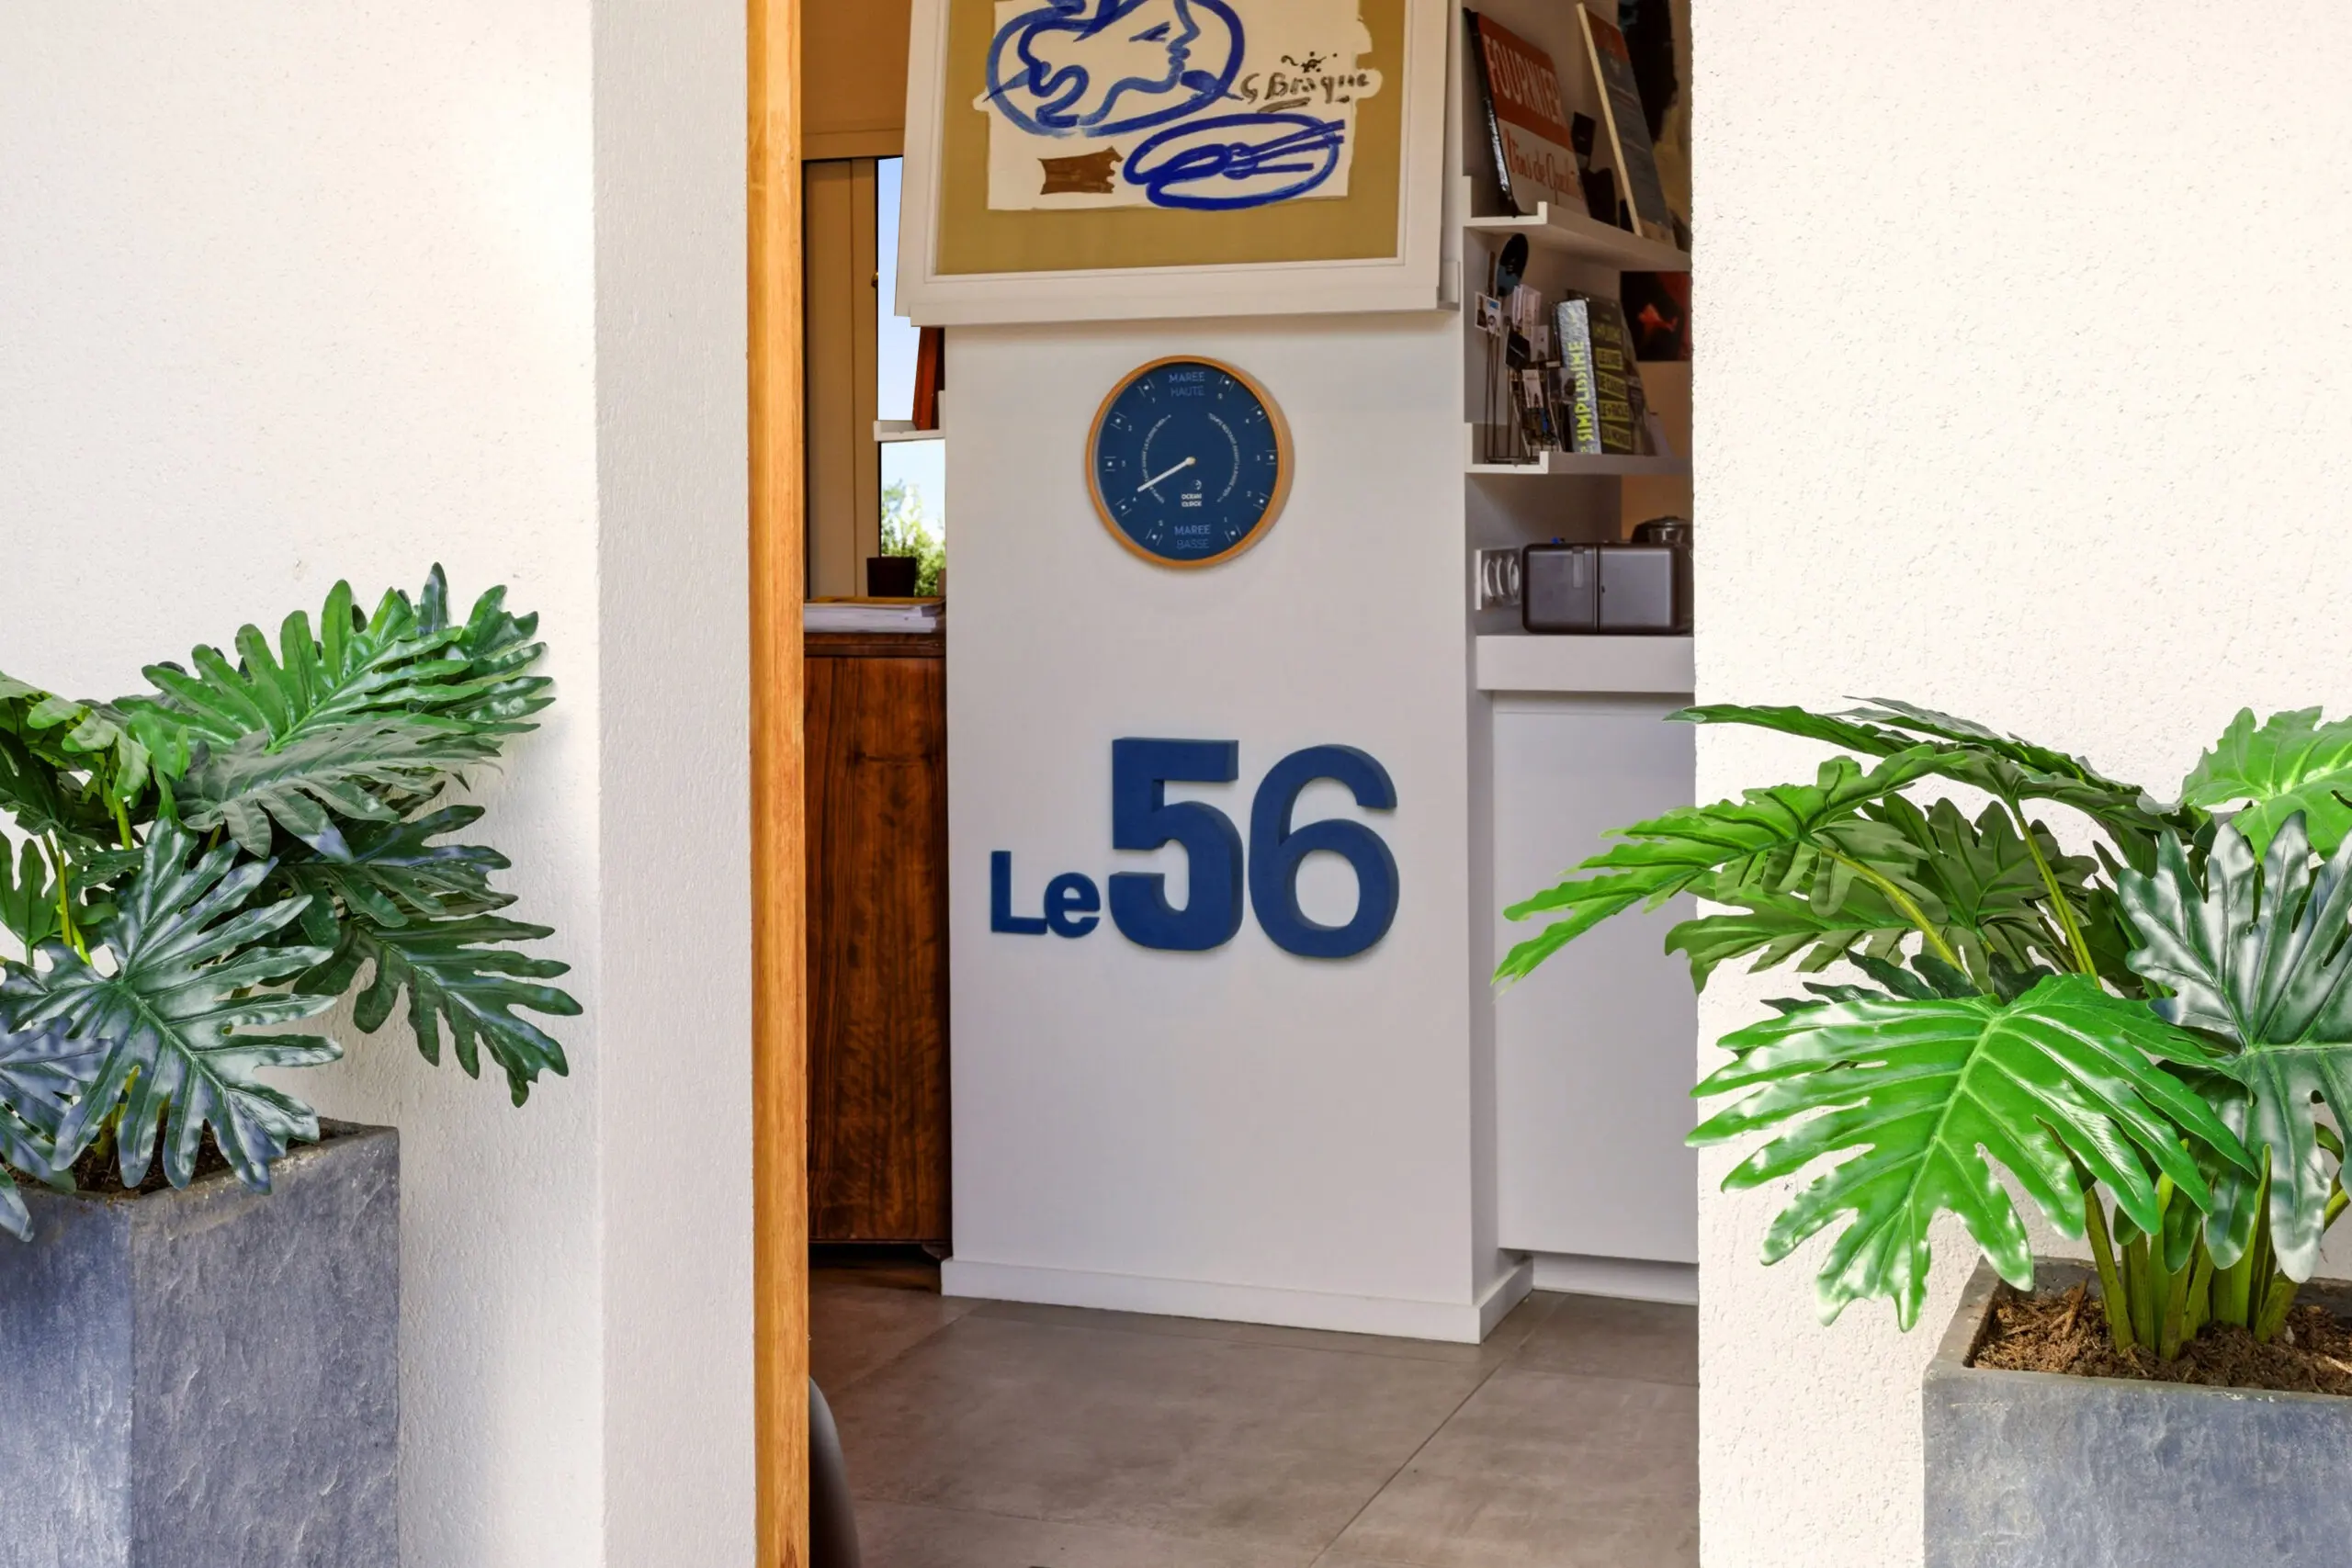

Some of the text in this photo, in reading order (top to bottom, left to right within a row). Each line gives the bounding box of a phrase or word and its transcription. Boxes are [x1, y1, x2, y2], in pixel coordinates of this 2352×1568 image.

[1170, 385, 1205, 396] HAUTE
[1568, 341, 1594, 442] SIMPLISSIME
[1176, 538, 1209, 549] BASSE
[990, 737, 1399, 958] Le 56
